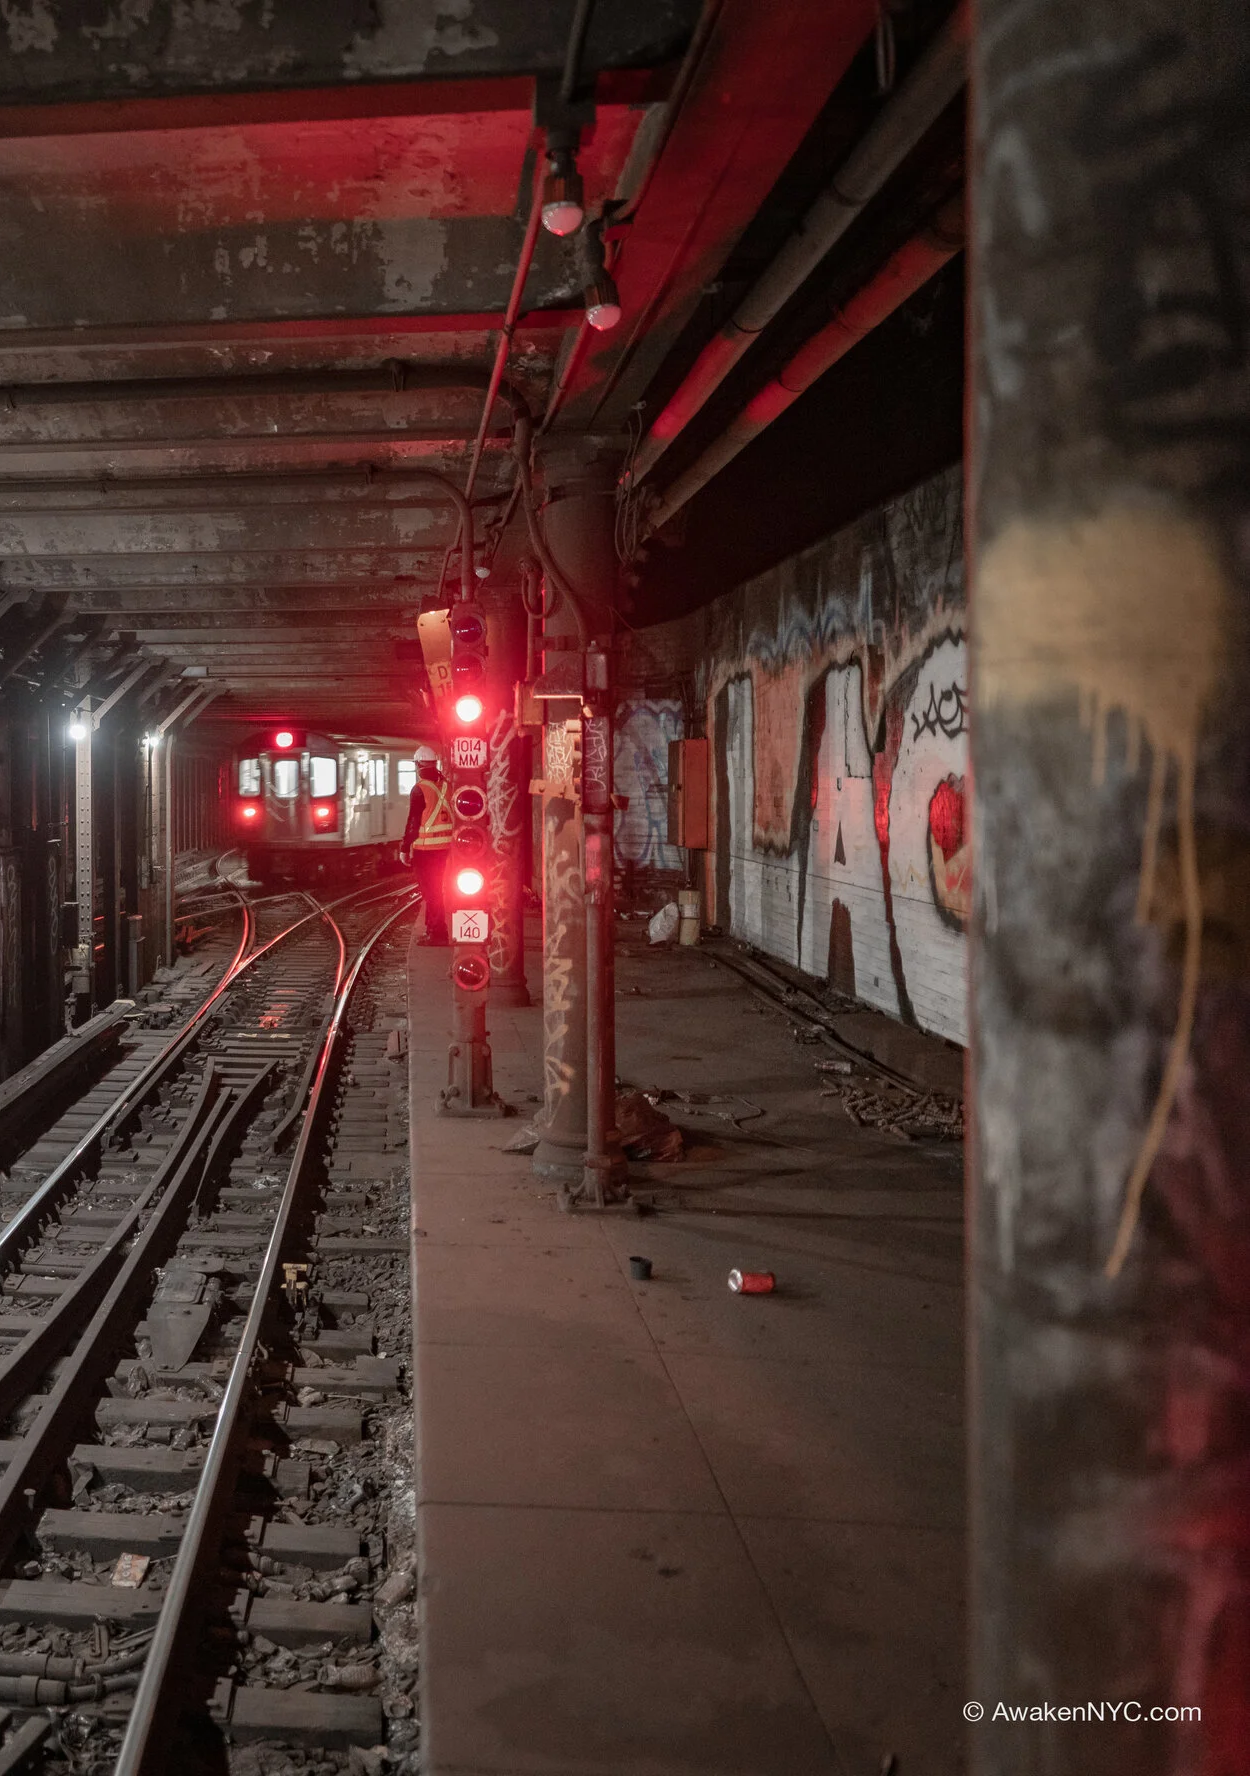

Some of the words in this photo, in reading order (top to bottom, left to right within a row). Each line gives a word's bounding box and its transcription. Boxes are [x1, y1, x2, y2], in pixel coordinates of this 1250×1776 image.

[457, 740, 481, 752] 1014
[459, 753, 479, 766] MM
[460, 926, 480, 939] 140
